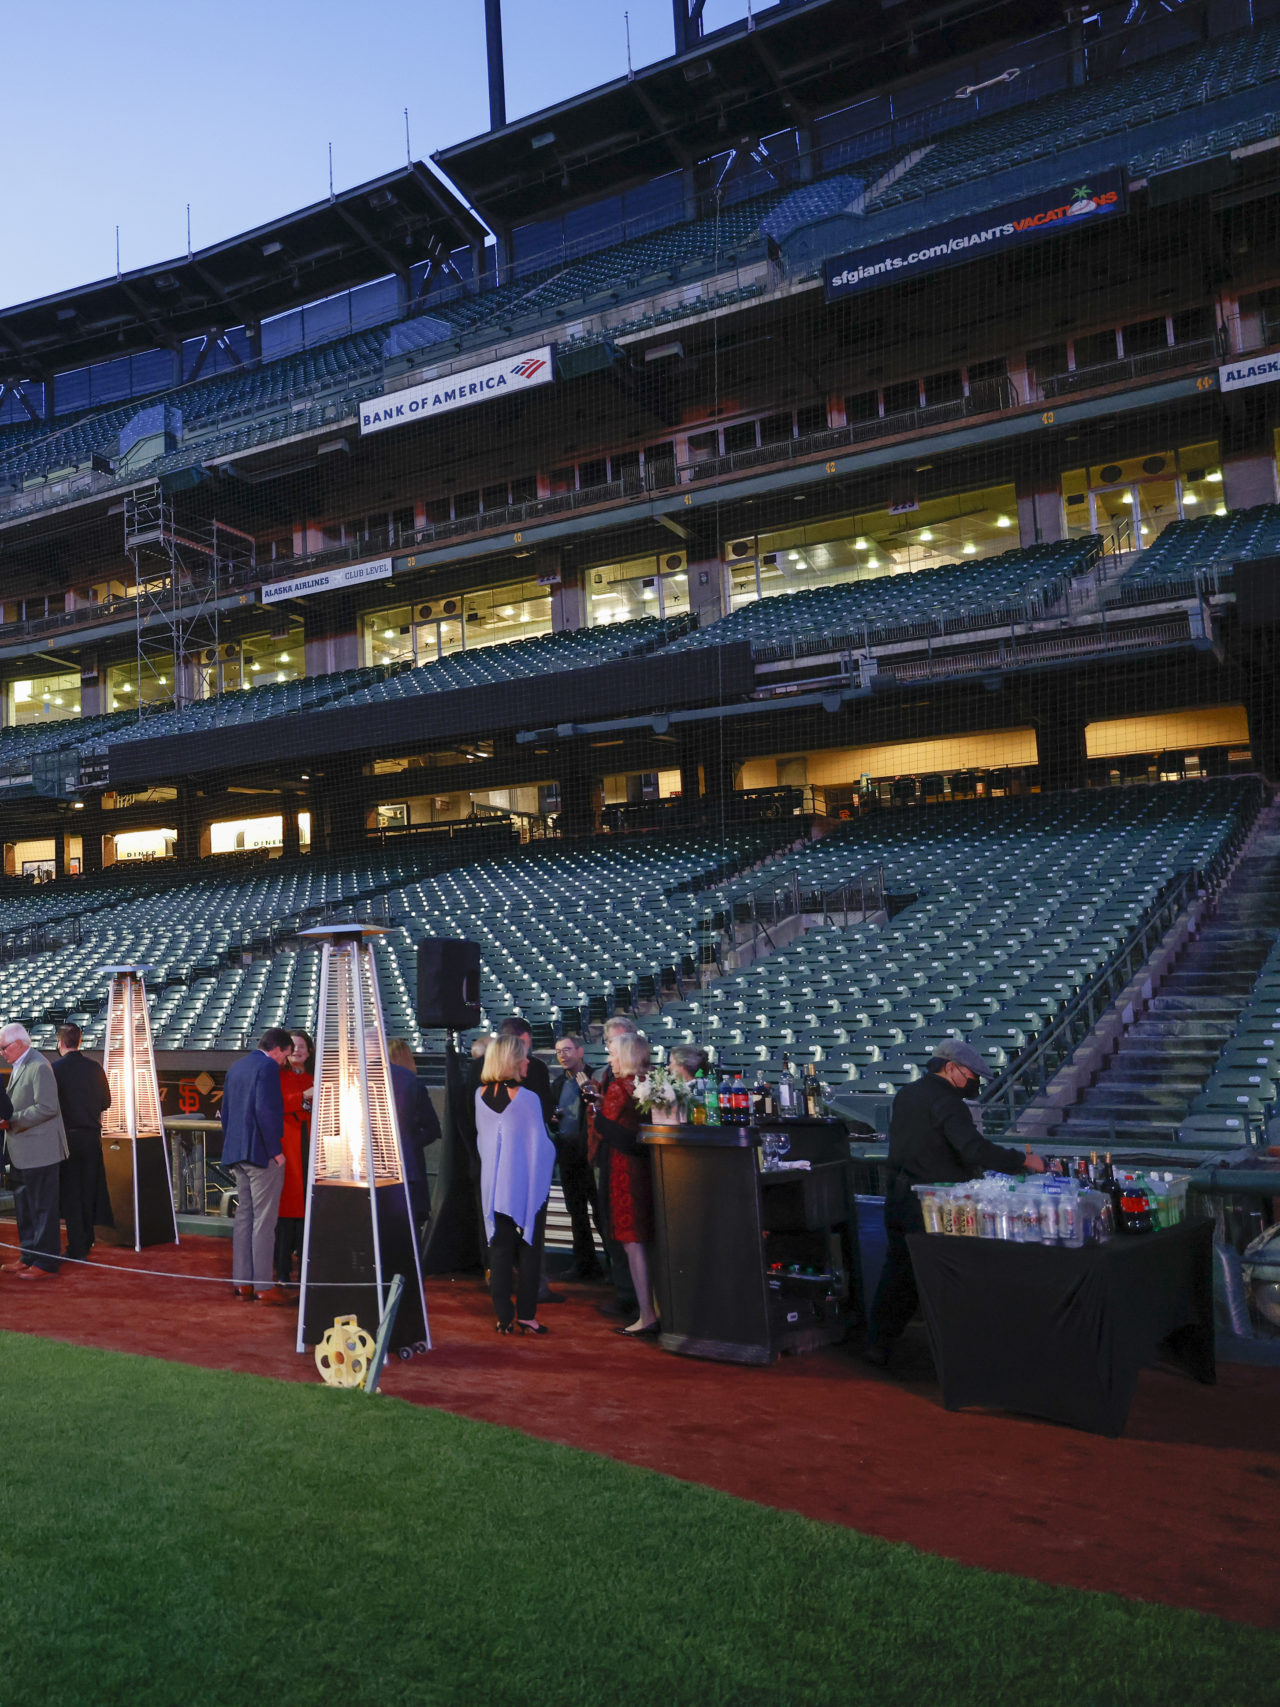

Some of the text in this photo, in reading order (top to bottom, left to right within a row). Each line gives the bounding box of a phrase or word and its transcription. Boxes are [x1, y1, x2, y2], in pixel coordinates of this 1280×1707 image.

[363, 374, 507, 427] BANK OF AMERICA
[1042, 411, 1054, 424] 43
[825, 461, 836, 474] 42
[683, 494, 692, 505] 41
[513, 532, 522, 543] 40
[264, 564, 389, 598] ALASKA AIRLINES CLUB LEVEL
[127, 850, 157, 859] DINER
